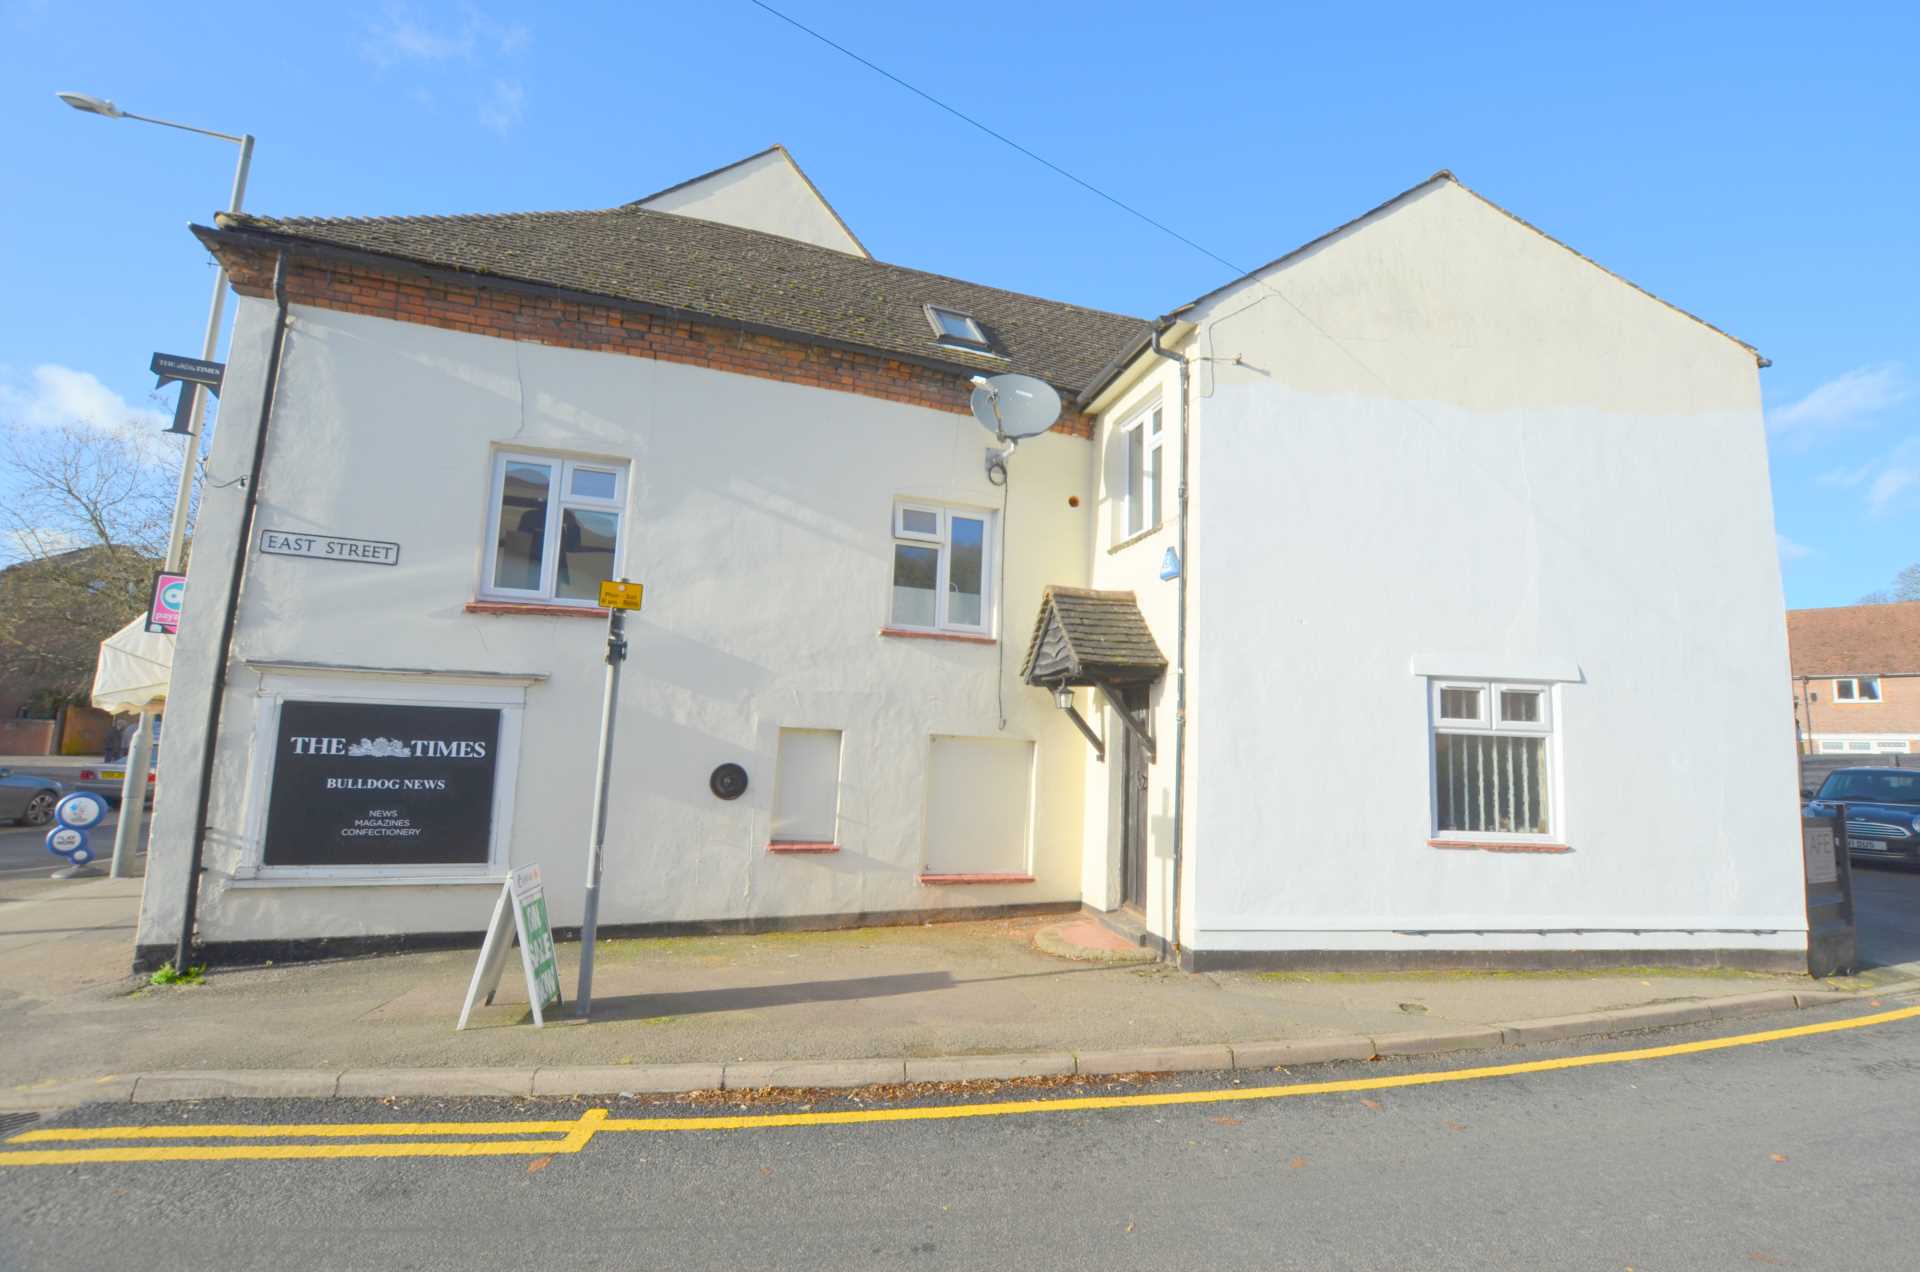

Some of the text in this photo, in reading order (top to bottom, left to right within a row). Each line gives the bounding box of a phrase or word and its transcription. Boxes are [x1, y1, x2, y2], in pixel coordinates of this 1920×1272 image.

[267, 535, 393, 560] EAST STREET
[290, 736, 487, 759] THE TIMES
[326, 778, 446, 791] BULLDOG NEWS
[368, 809, 398, 818] NEWS
[354, 818, 410, 827] MAGAZINES
[340, 827, 422, 837] CONFECTIONERY
